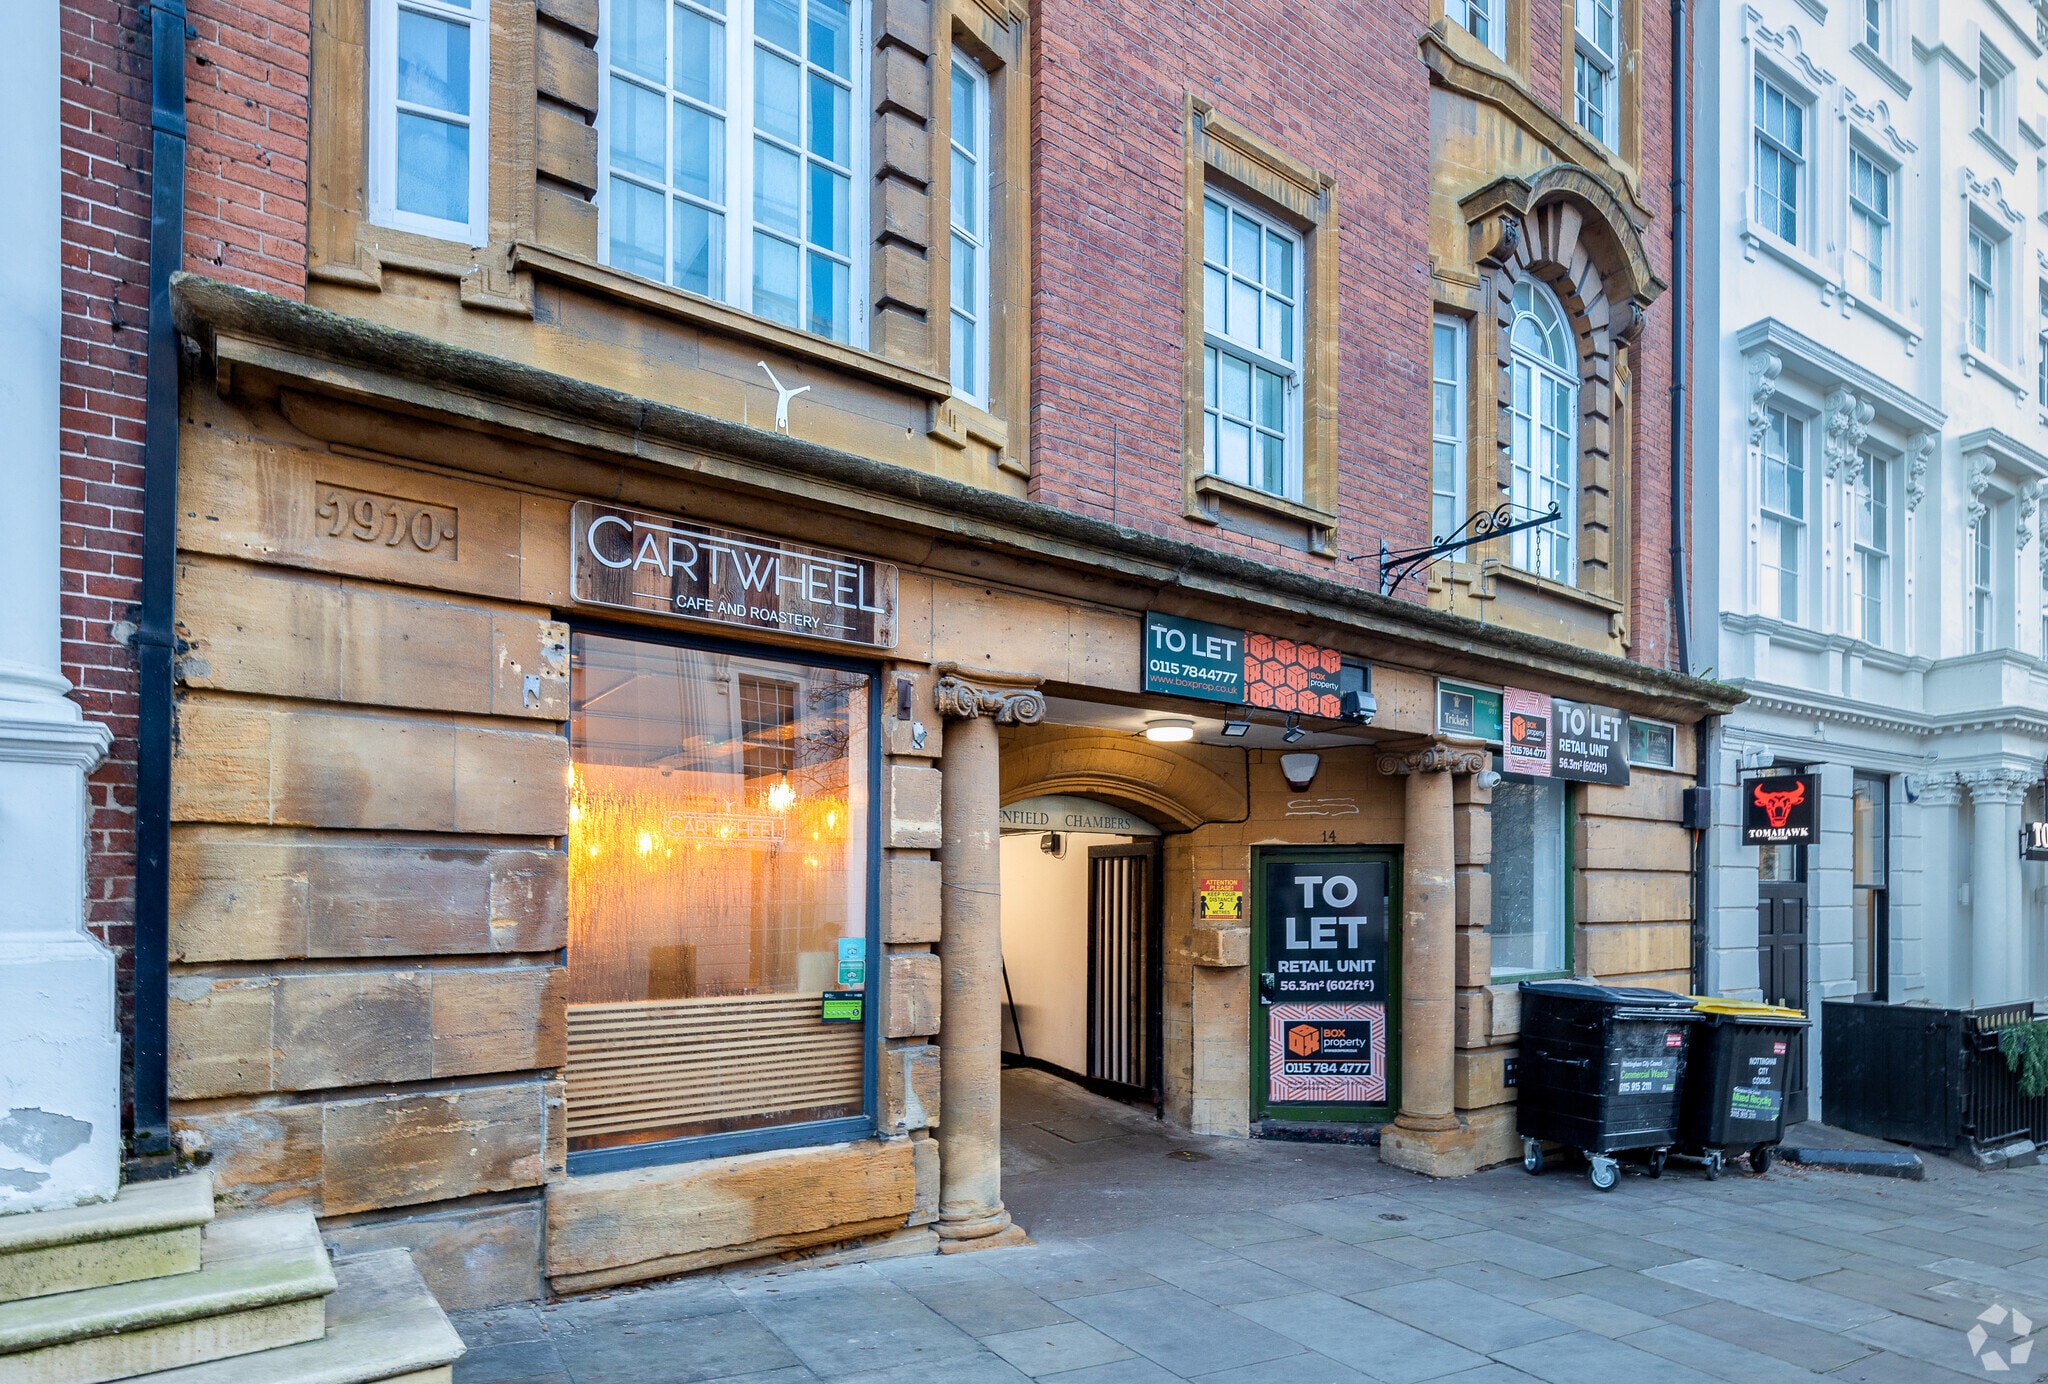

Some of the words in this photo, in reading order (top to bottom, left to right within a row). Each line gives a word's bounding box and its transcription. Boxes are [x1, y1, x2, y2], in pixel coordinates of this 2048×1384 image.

[588, 515, 886, 614] CARTWHEEL
[676, 594, 714, 613] CAFE
[717, 601, 747, 618] AND
[750, 606, 820, 629] ROASTERY
[1150, 624, 1186, 653] TO
[1192, 633, 1237, 662] LET
[1150, 659, 1180, 675] 0115
[1181, 664, 1238, 684] 7844777
[1310, 672, 1326, 681] BOX
[1150, 674, 1238, 695] www.boxprop.co.uk
[1310, 680, 1339, 691] property
[1444, 711, 1470, 727] Tricker's
[1558, 705, 1586, 736] TO
[1590, 713, 1622, 742] LET
[1526, 729, 1546, 738] property
[1559, 738, 1588, 755] RETAIL
[1589, 743, 1609, 758] UNIT
[667, 815, 783, 839] CARTWHEEL
[1065, 814, 1131, 830] CHAMBERS
[1322, 830, 1337, 842] 14
[1748, 827, 1809, 839] TOMAHAWK
[1294, 875, 1358, 908] TO
[1218, 901, 1225, 910] 2
[1285, 916, 1367, 949] LET
[1278, 960, 1333, 973] RETAIL
[1336, 959, 1376, 972] UNIT
[1323, 1028, 1346, 1038] BOX
[1323, 1038, 1366, 1048] property
[1749, 1057, 1777, 1065] NOTTINGHAM
[1285, 1063, 1312, 1073] 0115
[1313, 1063, 1337, 1073] 784
[1339, 1063, 1370, 1073] 4777
[1620, 1070, 1650, 1080] Commercial
[1651, 1069, 1669, 1078] Waste
[1758, 1067, 1769, 1075] CITY
[1752, 1077, 1771, 1085] COUNCIL
